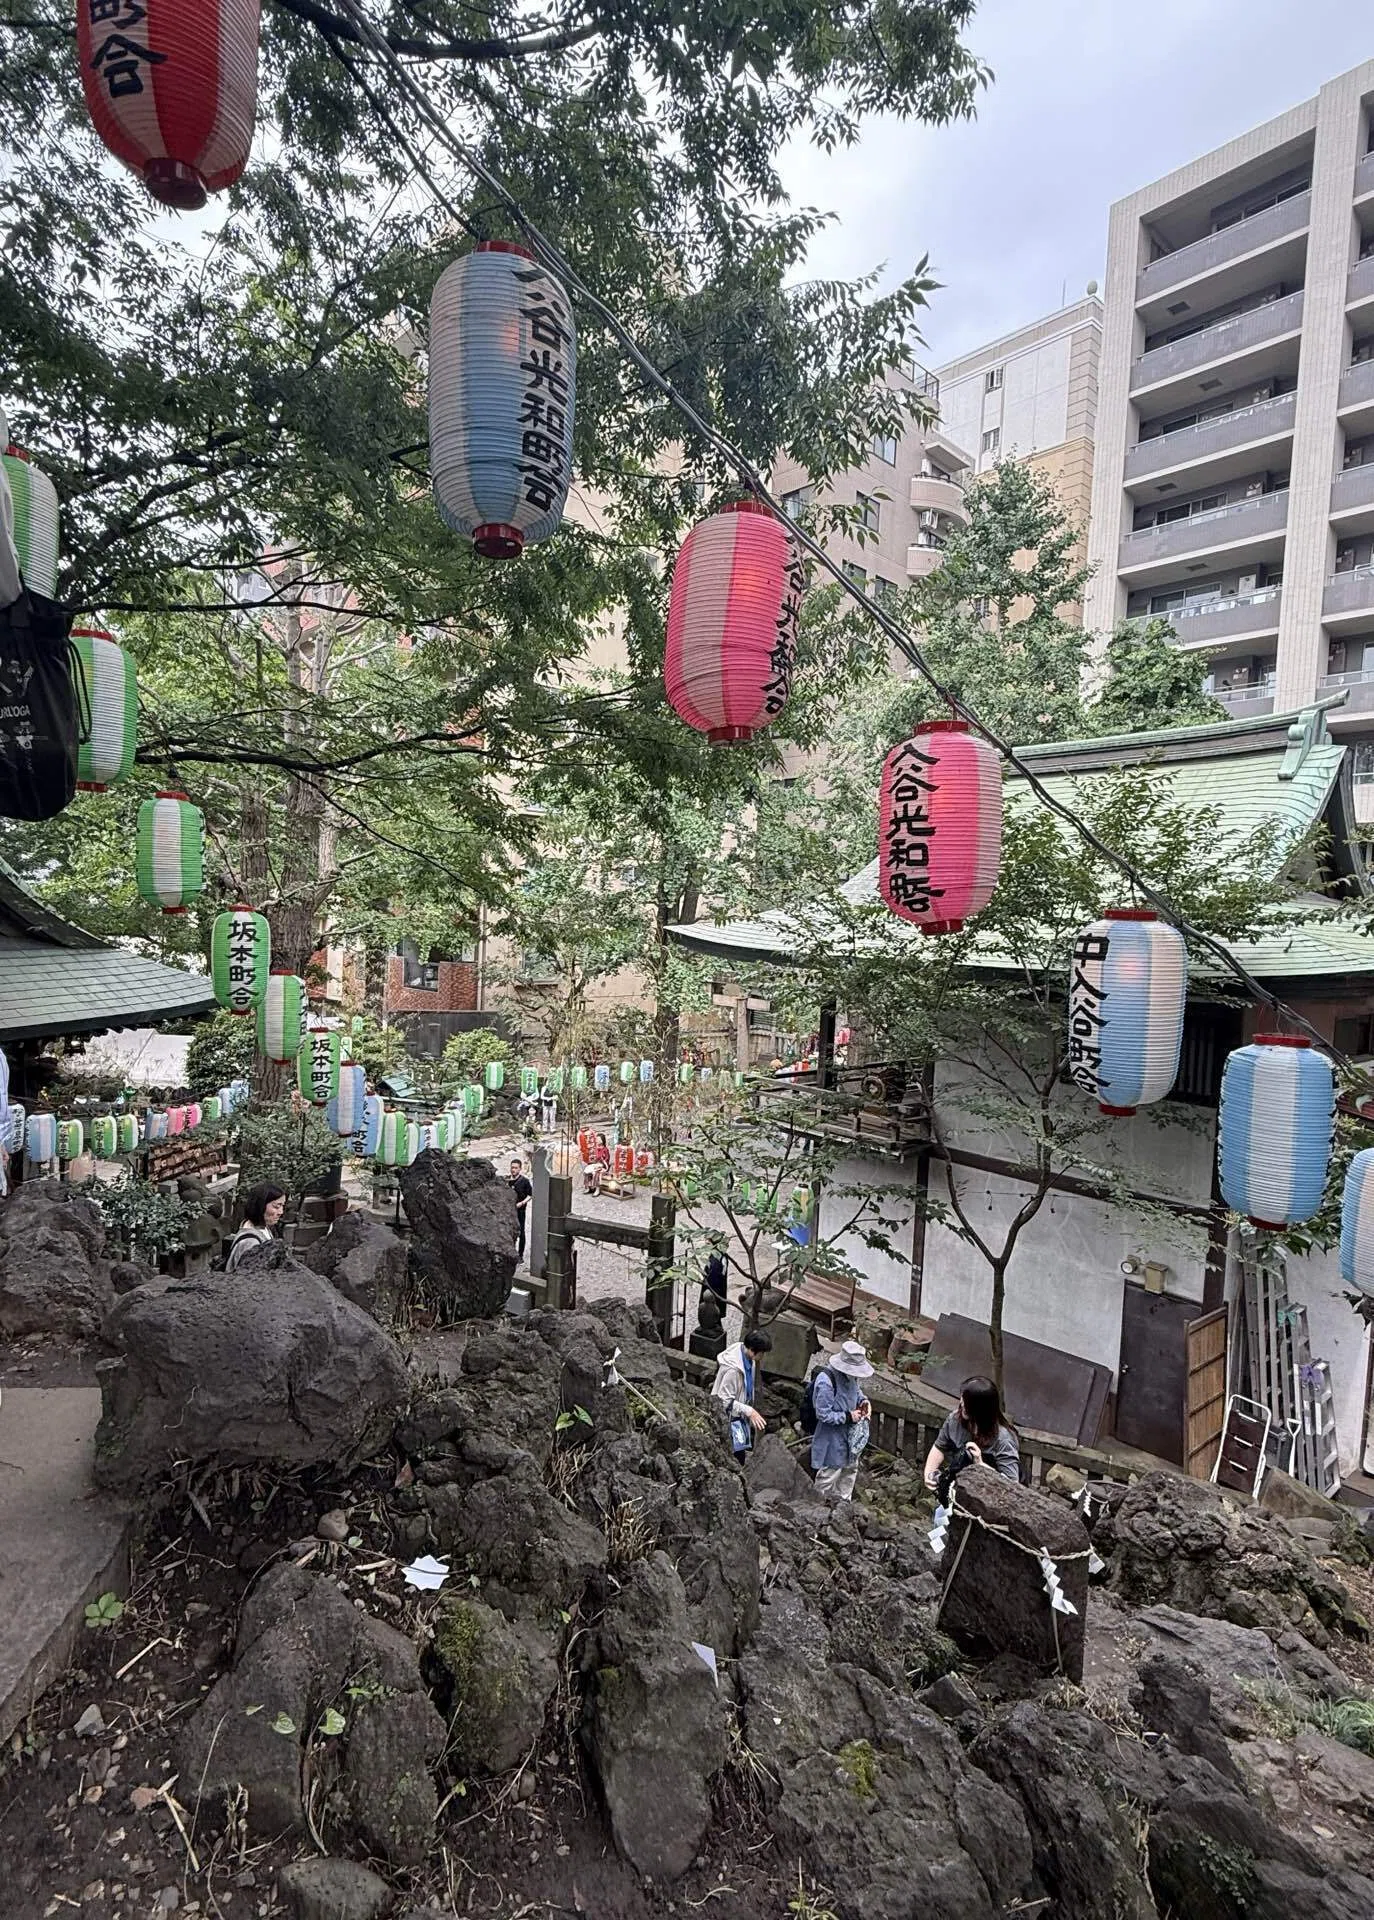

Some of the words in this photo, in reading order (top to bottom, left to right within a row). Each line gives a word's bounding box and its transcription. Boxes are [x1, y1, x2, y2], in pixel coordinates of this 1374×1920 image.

[226, 920, 261, 1005] 坂本町会
[1069, 933, 1111, 1094] 中入谷町会
[309, 1038, 335, 1098] 坂本町会
